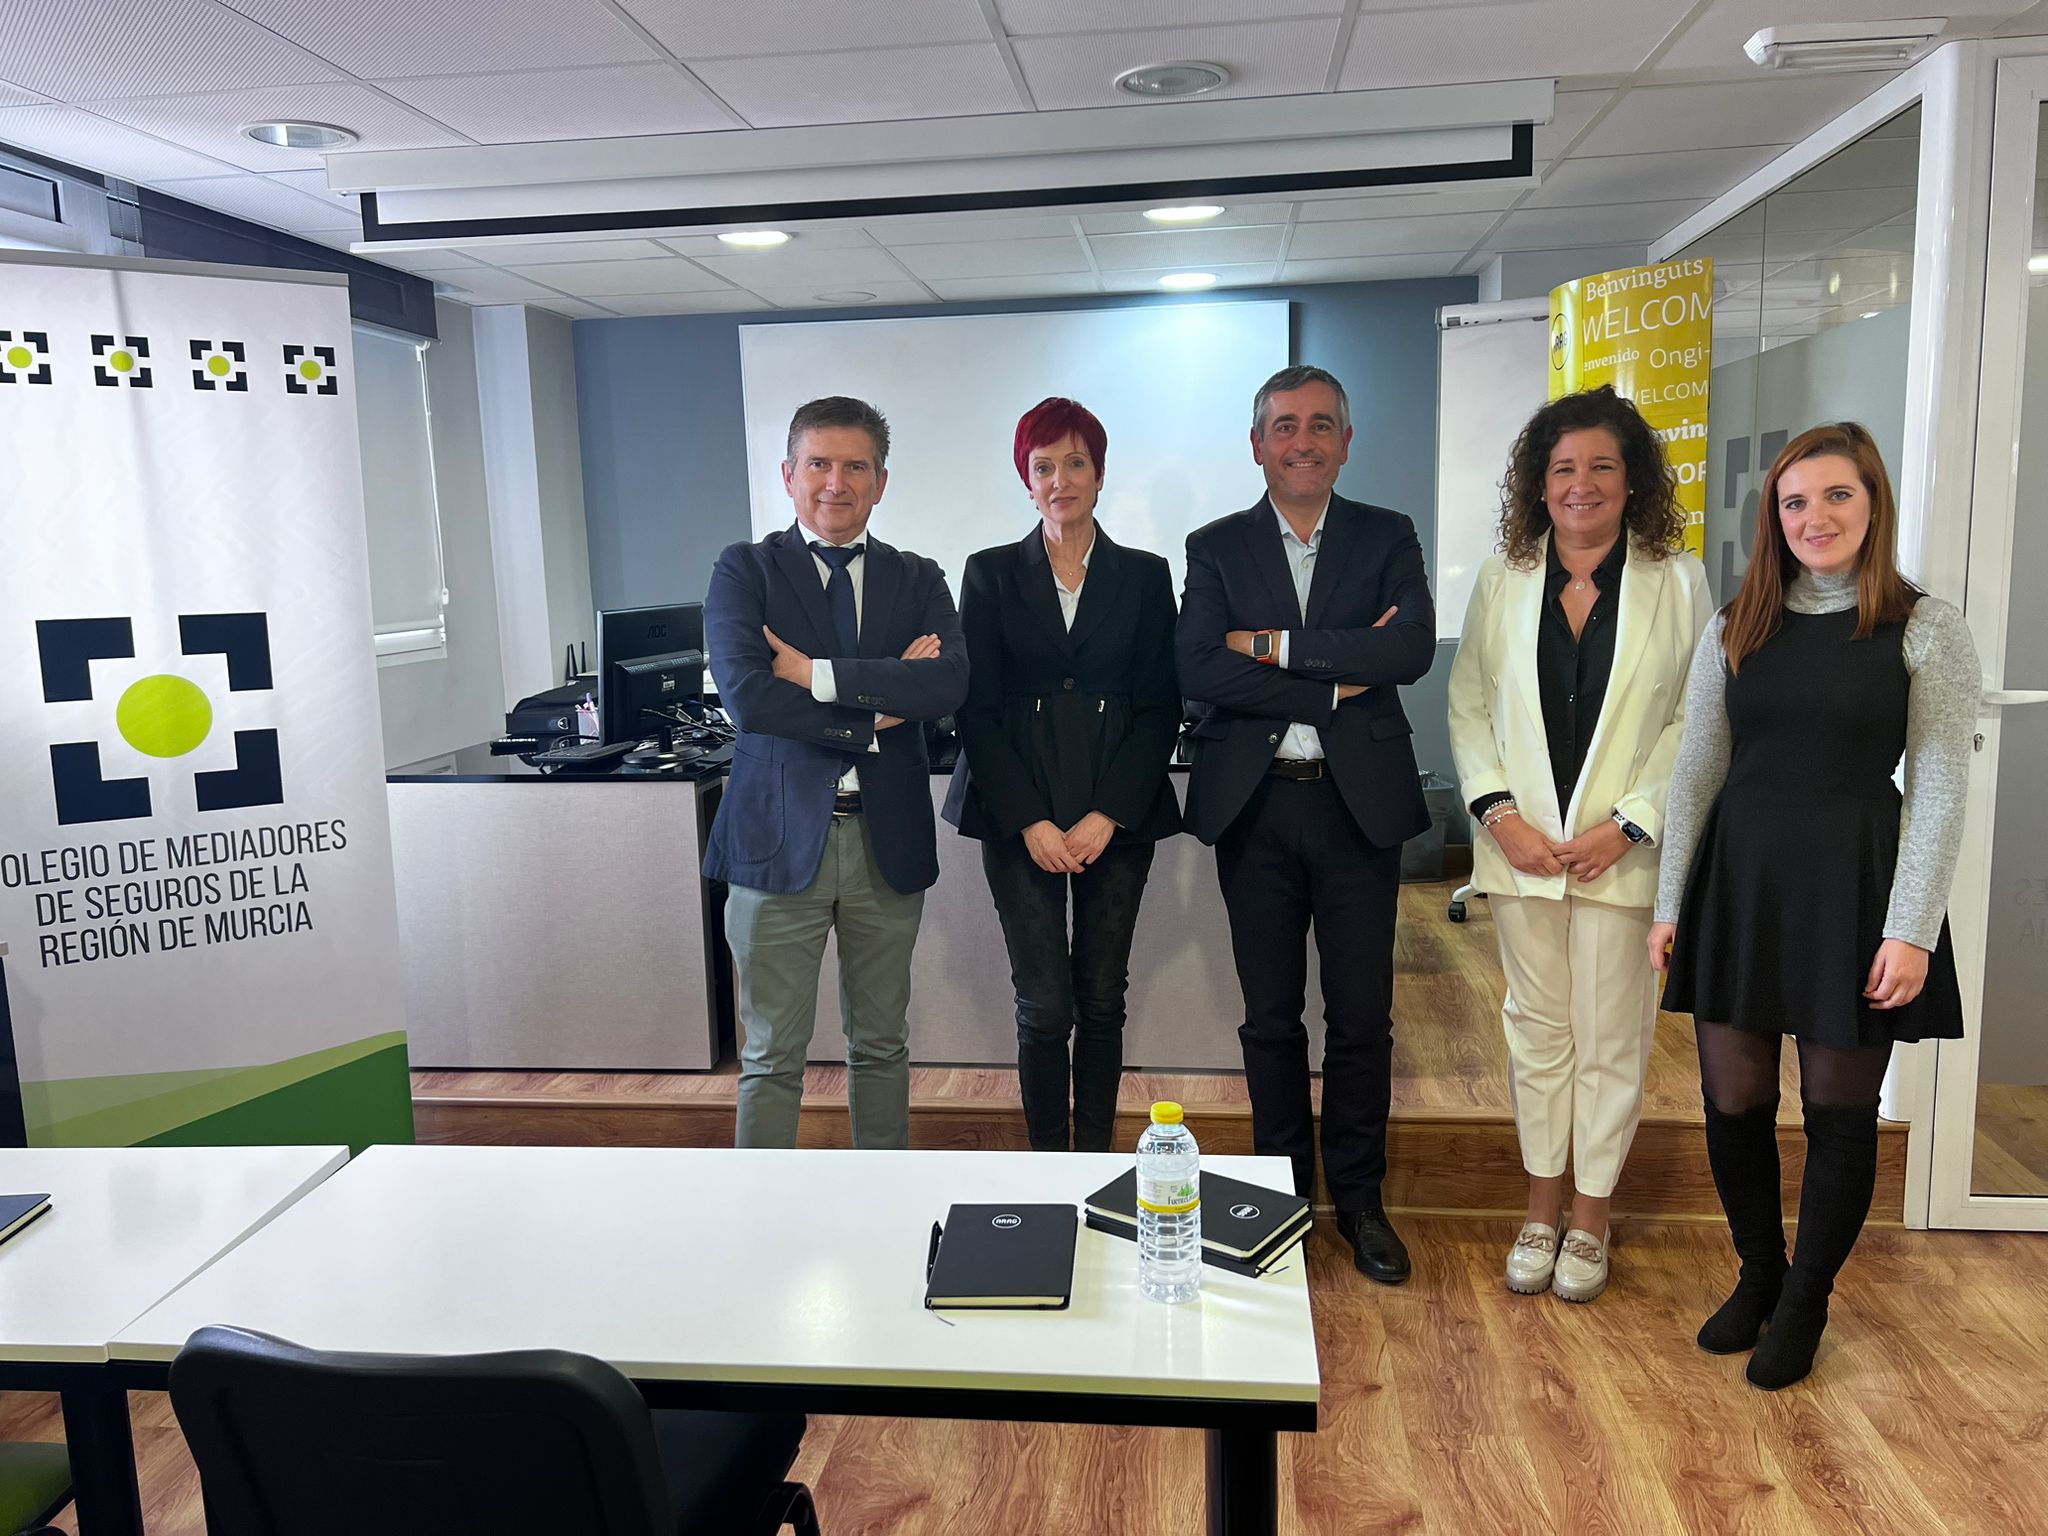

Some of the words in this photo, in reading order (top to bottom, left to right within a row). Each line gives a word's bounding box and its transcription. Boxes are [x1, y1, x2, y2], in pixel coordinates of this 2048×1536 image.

[1586, 259, 1704, 302] Benvinguts
[1583, 292, 1713, 346] WELCOM
[1634, 380, 1709, 405] ELCOM
[648, 623, 667, 640] AOC
[1, 844, 110, 888] OLEGIO
[118, 839, 158, 875] DE
[166, 819, 348, 869] MEDIADORES
[35, 889, 76, 927] DE
[84, 873, 222, 920] SEGUROS
[229, 867, 266, 902] DE
[273, 862, 310, 896] LA
[39, 918, 151, 969] REGIÓN
[158, 915, 197, 951] DE
[204, 901, 314, 945] MURCIA
